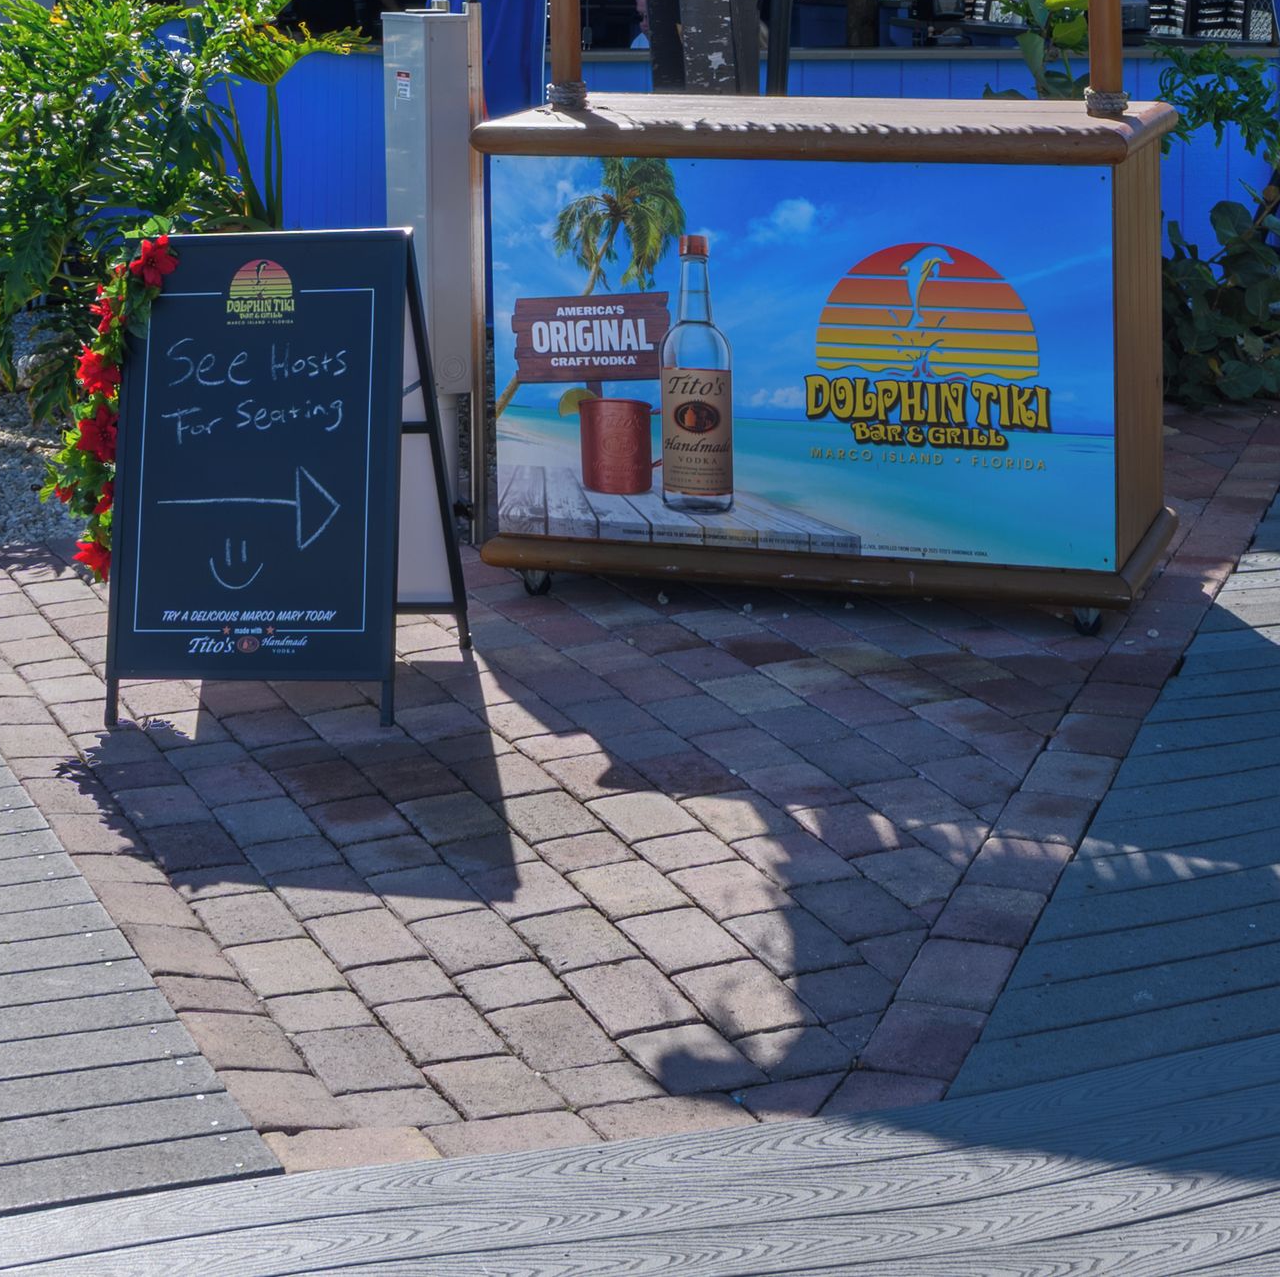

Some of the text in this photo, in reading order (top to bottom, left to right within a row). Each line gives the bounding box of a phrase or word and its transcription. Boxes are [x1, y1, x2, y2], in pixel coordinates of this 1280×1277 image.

[226, 299, 295, 313] DOLPHIN TIKI
[556, 305, 625, 316] AMERICA'S
[532, 318, 654, 354] ORIGINAL
[166, 338, 347, 386] See Hosts
[550, 356, 637, 366] CRAFT VODKA
[668, 374, 726, 396] Tito's
[804, 374, 1052, 432] DOLPHIN TIKI
[161, 399, 344, 444] For Seating
[905, 425, 924, 446] &
[926, 426, 1008, 451] GRILL
[678, 456, 720, 466] VODKA
[810, 447, 1046, 470] MARCO ISLAND FLORIDA
[162, 610, 336, 622] TRY A DELICIOUS MARCO MARY TODAY
[188, 635, 308, 654] Tito's Handmade
